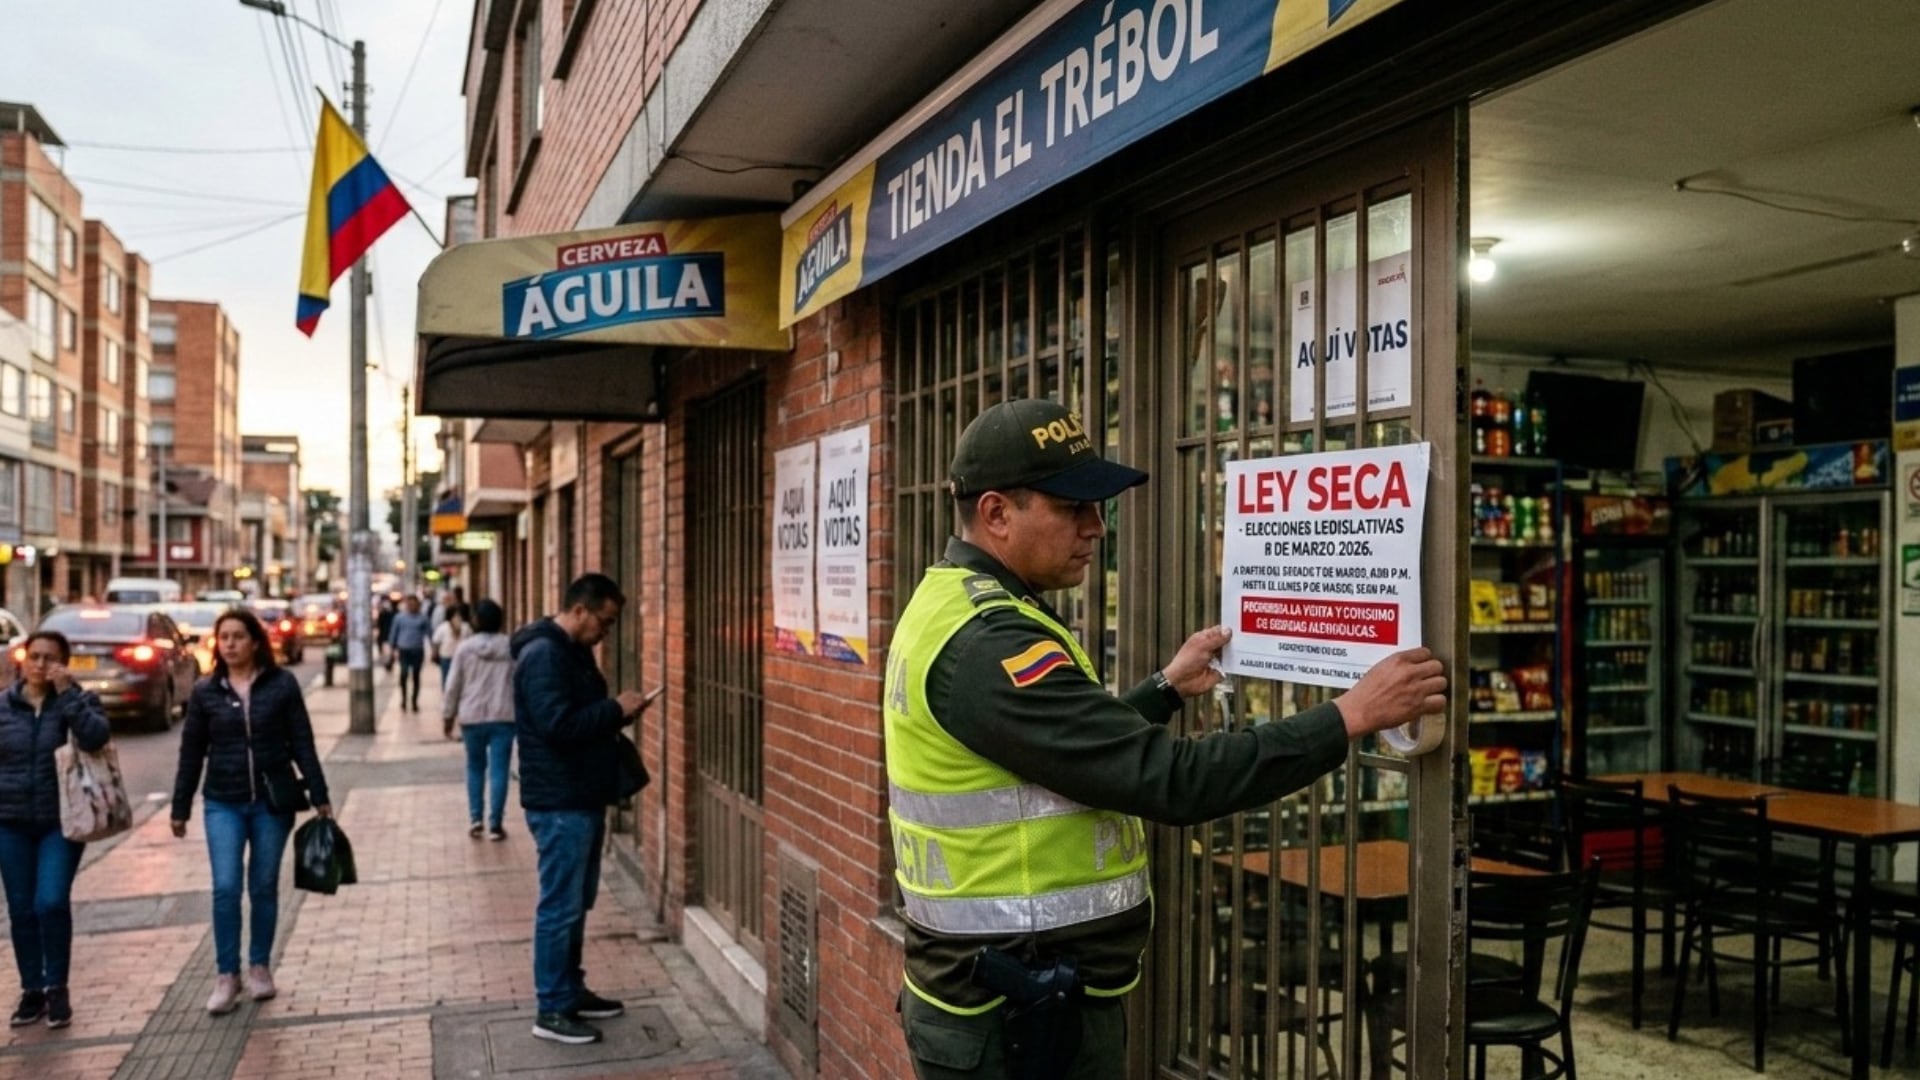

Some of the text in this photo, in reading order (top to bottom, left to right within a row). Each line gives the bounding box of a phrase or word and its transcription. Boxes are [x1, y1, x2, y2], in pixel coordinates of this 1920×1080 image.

[887, 0, 1219, 241] TIENDA EL TRÉBOL
[561, 237, 661, 266] CERVEZA
[517, 263, 711, 337] ÁGUILA
[828, 469, 857, 515] AQUÍ
[1238, 461, 1411, 514] LEY SECA
[824, 515, 861, 548] VOTAS
[1245, 521, 1311, 537] ELECCIONES
[1275, 541, 1290, 556] DE
[1291, 541, 1335, 556] MARZO
[1335, 606, 1342, 618] Y
[1343, 606, 1396, 622] CONSUMO
